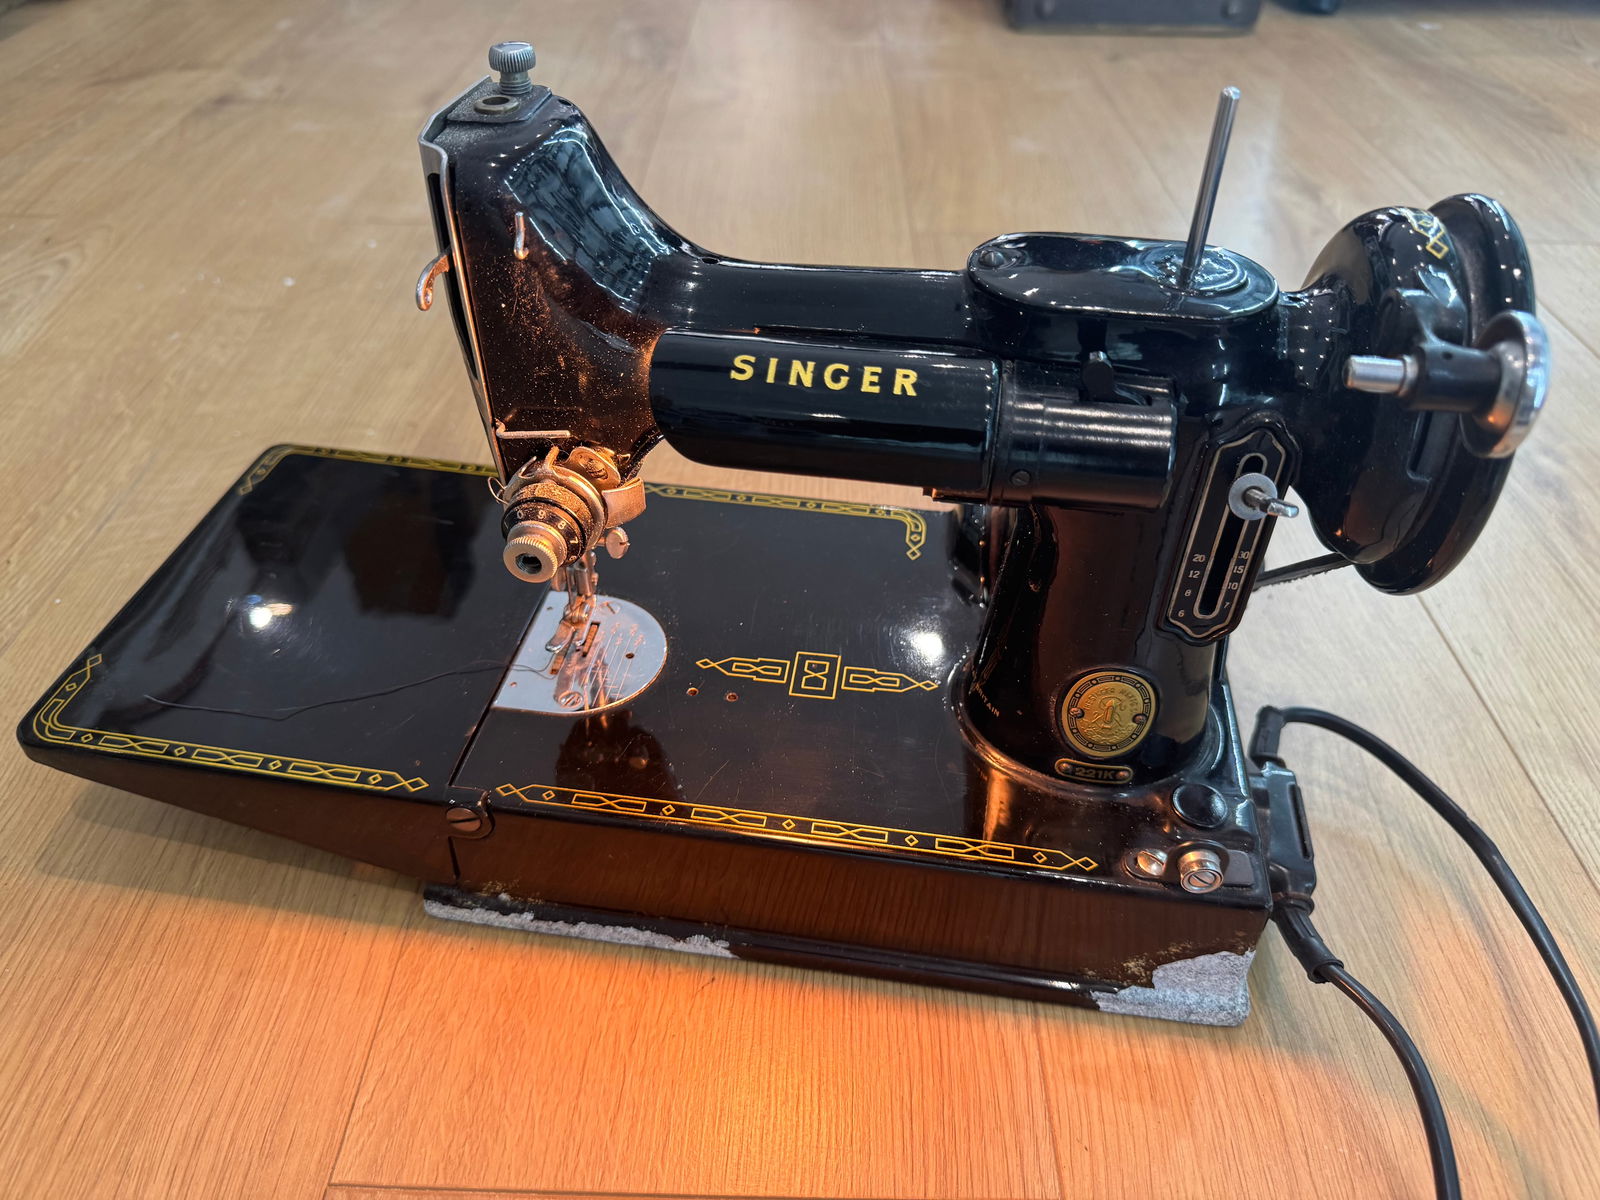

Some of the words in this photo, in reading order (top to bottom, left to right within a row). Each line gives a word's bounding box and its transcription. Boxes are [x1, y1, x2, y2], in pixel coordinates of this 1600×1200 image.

[730, 355, 918, 396] SINGER
[537, 510, 546, 519] 9
[557, 521, 567, 530] 8
[569, 536, 579, 544] 7
[1193, 553, 1206, 563] 20
[1233, 565, 1244, 574] 15
[1188, 570, 1200, 579] 12
[1228, 582, 1238, 590] 10
[1184, 589, 1192, 597] 8
[1178, 609, 1185, 617] 6
[1075, 766, 1116, 779] 221K
